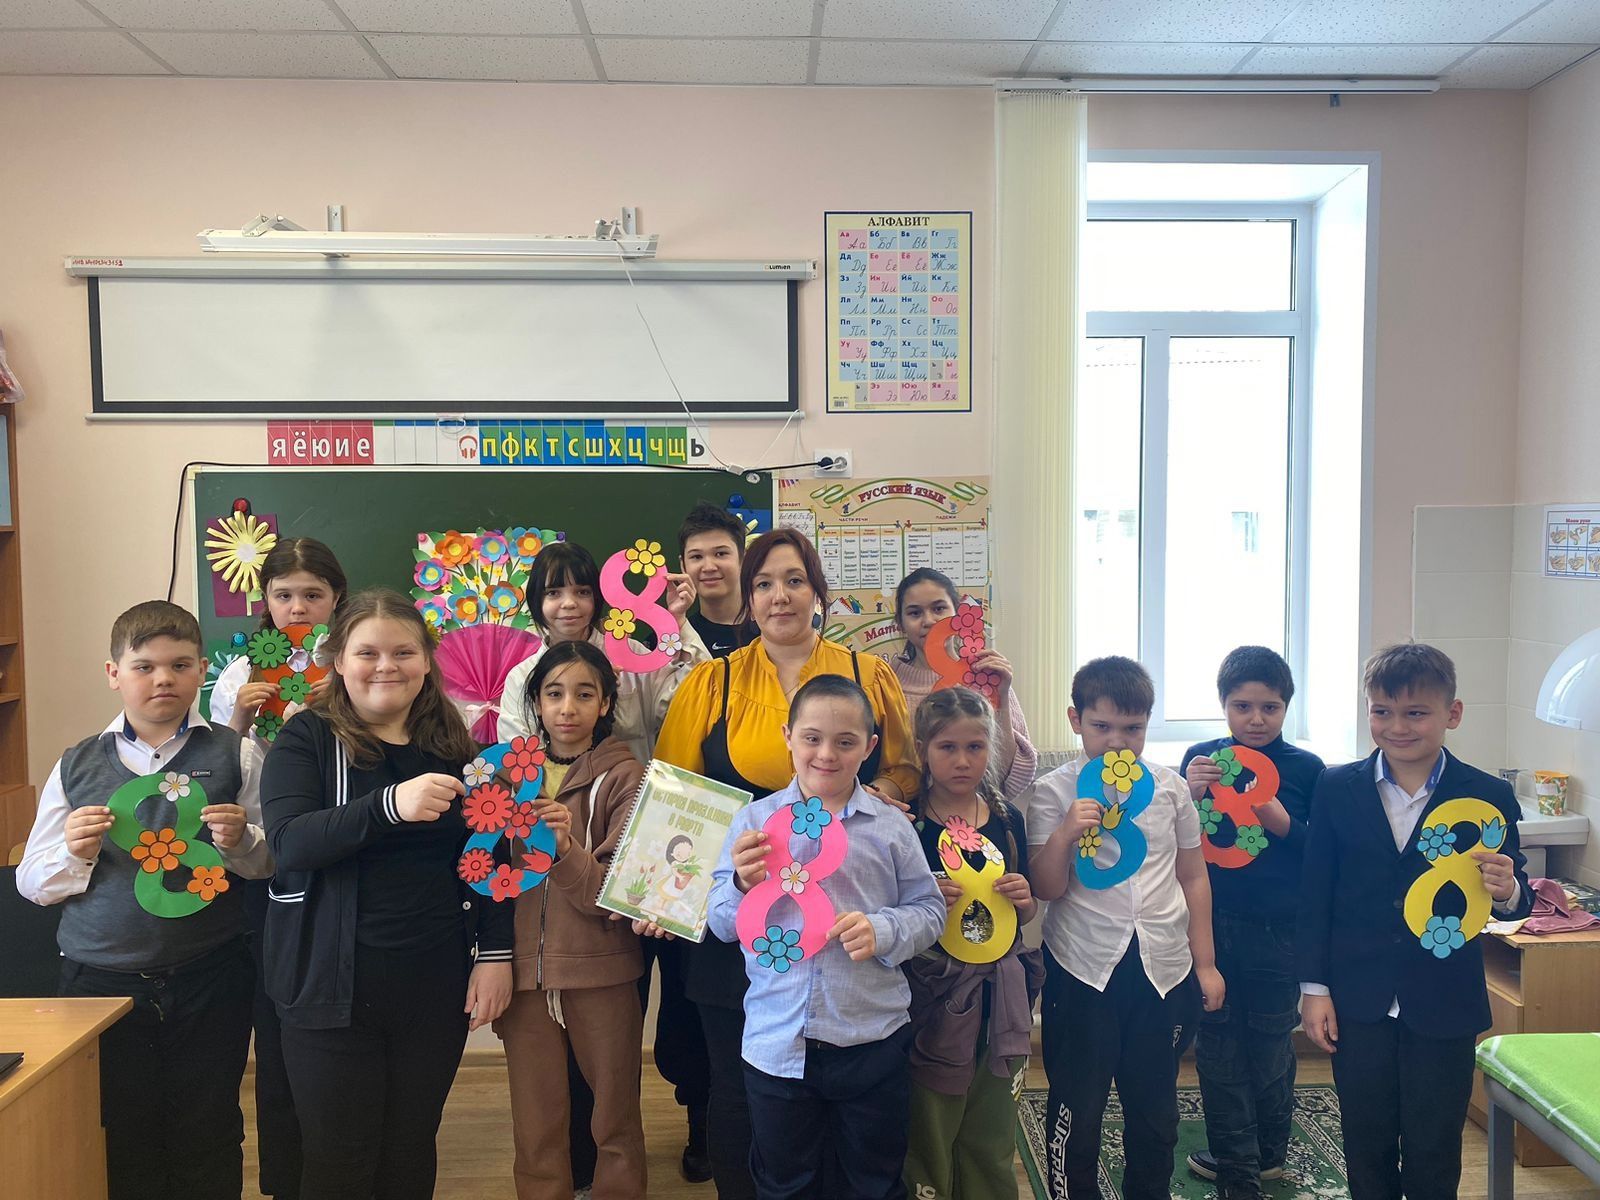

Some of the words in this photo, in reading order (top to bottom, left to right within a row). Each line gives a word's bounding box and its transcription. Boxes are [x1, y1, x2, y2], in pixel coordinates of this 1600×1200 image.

[868, 217, 930, 226] АЛФАВИТ
[858, 483, 913, 503] РУССКИЙ
[914, 486, 947, 505] ЯЗЫК
